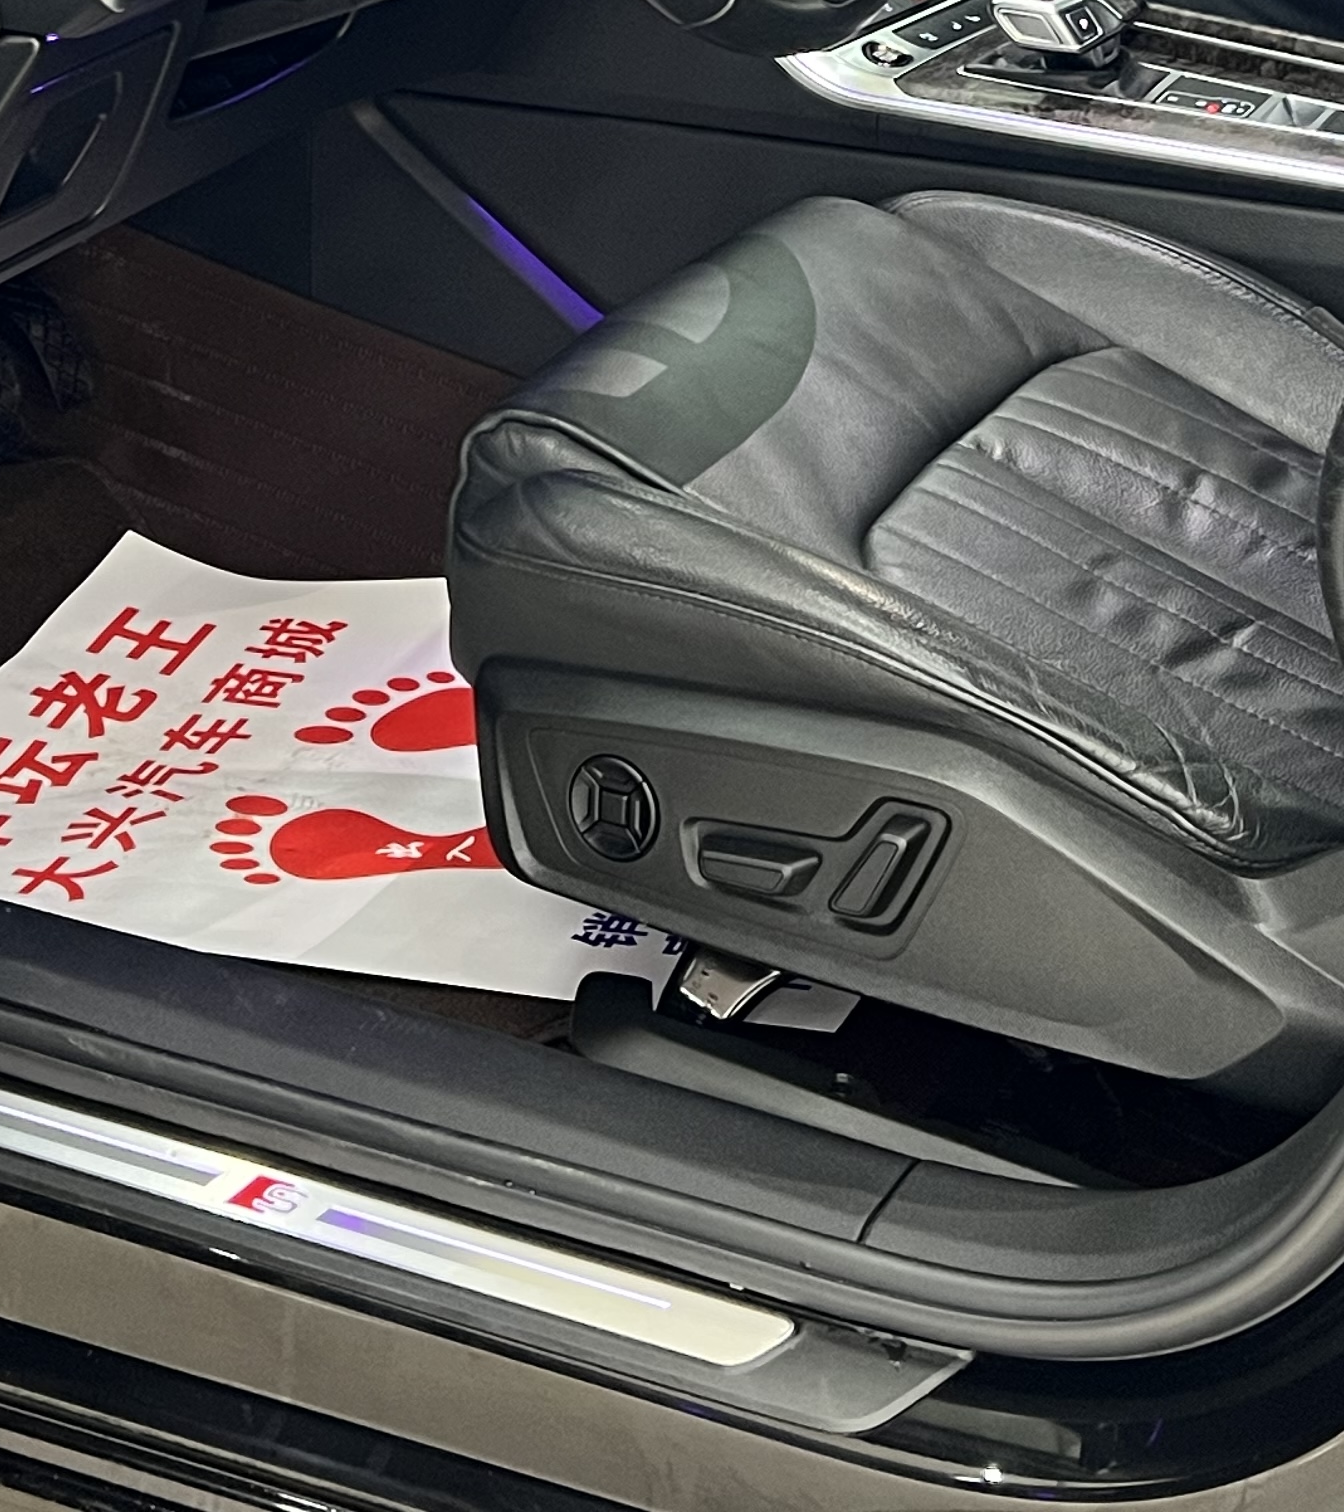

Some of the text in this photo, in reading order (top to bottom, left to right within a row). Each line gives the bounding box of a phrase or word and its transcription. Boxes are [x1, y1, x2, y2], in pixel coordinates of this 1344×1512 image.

[12, 617, 348, 902] 大兴汽车商城
